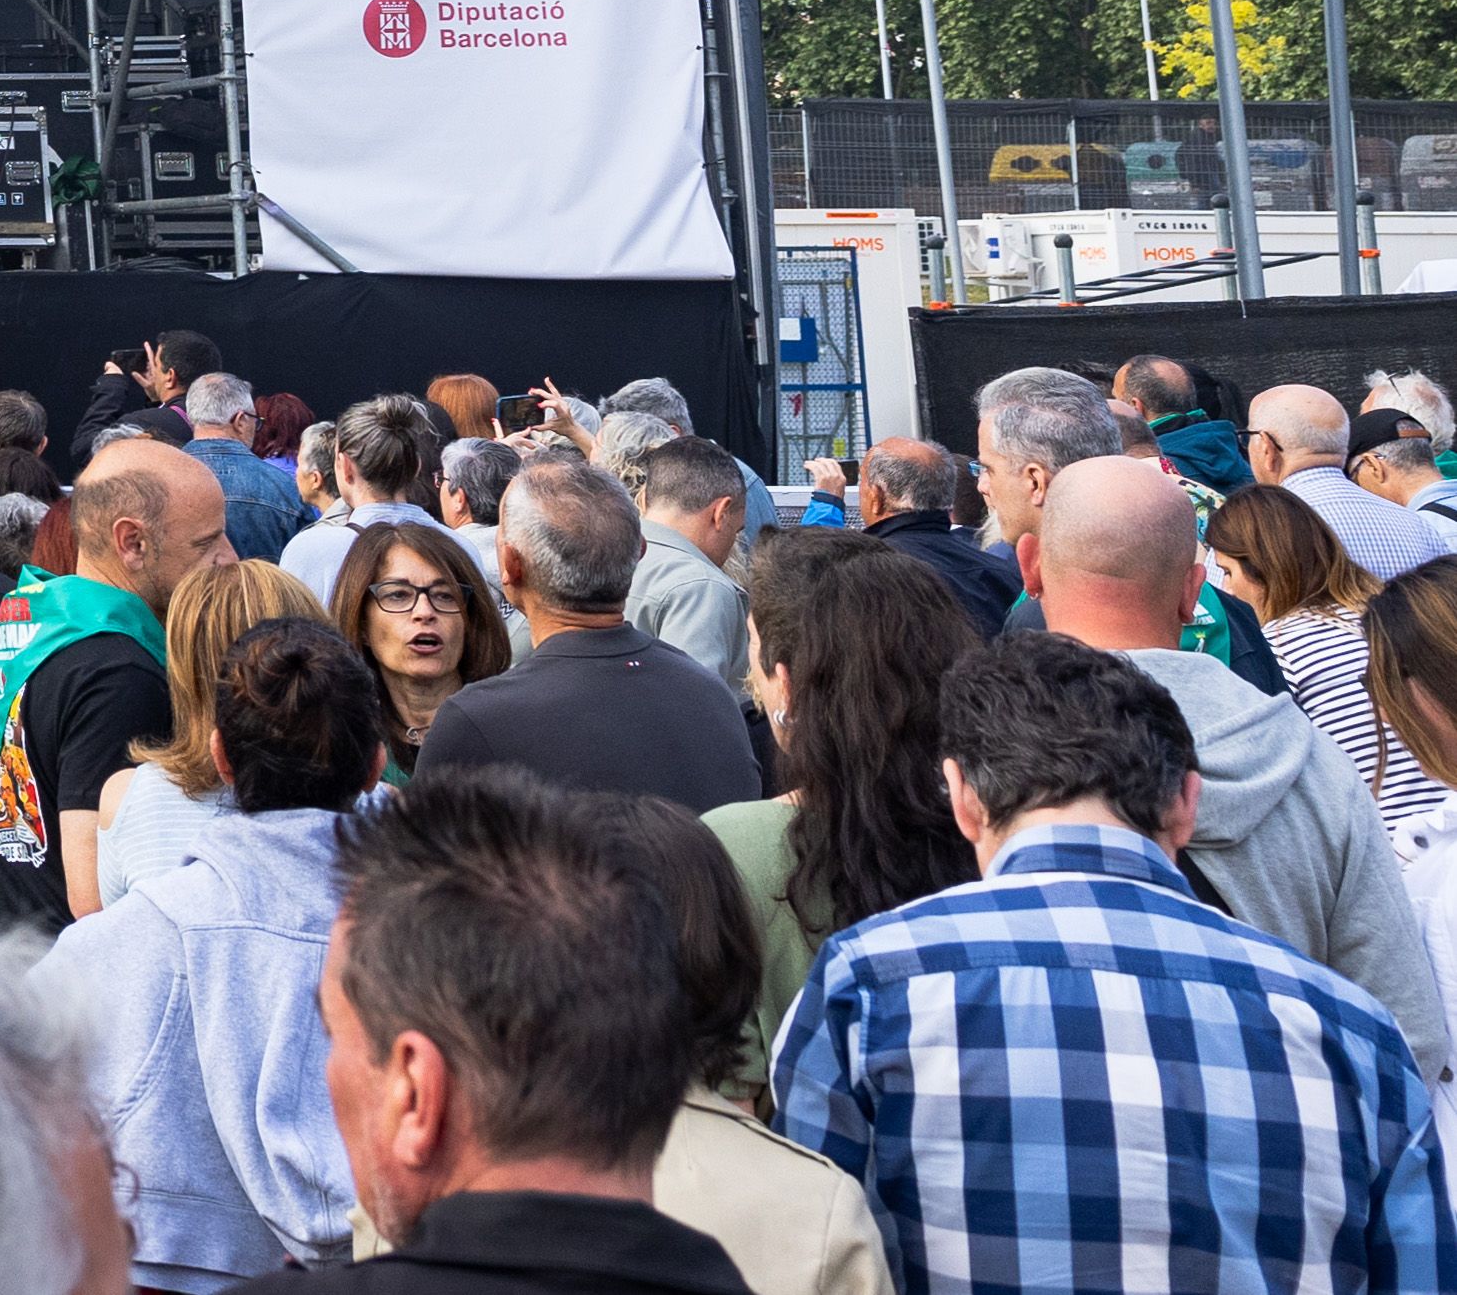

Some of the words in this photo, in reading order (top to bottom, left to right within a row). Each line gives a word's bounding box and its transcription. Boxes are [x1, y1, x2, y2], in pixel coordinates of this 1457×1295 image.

[438, 1, 565, 25] Diputació
[440, 29, 568, 49] Barcelona
[833, 237, 884, 251] HOMS
[1143, 247, 1196, 261] HOMS
